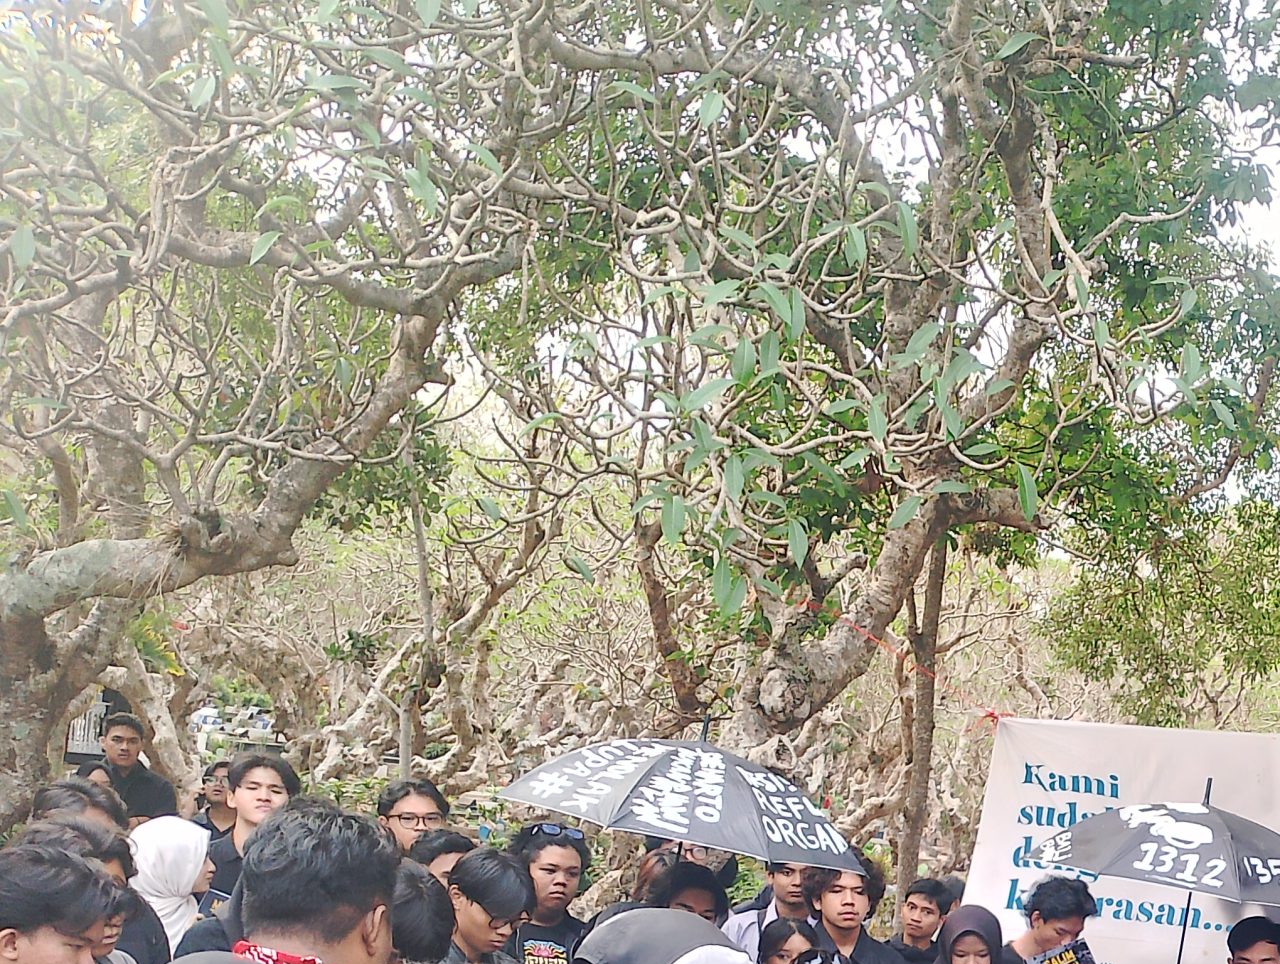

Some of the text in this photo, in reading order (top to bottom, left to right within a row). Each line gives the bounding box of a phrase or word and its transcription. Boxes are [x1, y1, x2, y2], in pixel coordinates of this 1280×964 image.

[1022, 762, 1120, 799] Kami
[1017, 802, 1118, 829] sud
[1133, 843, 1227, 888] 1312
